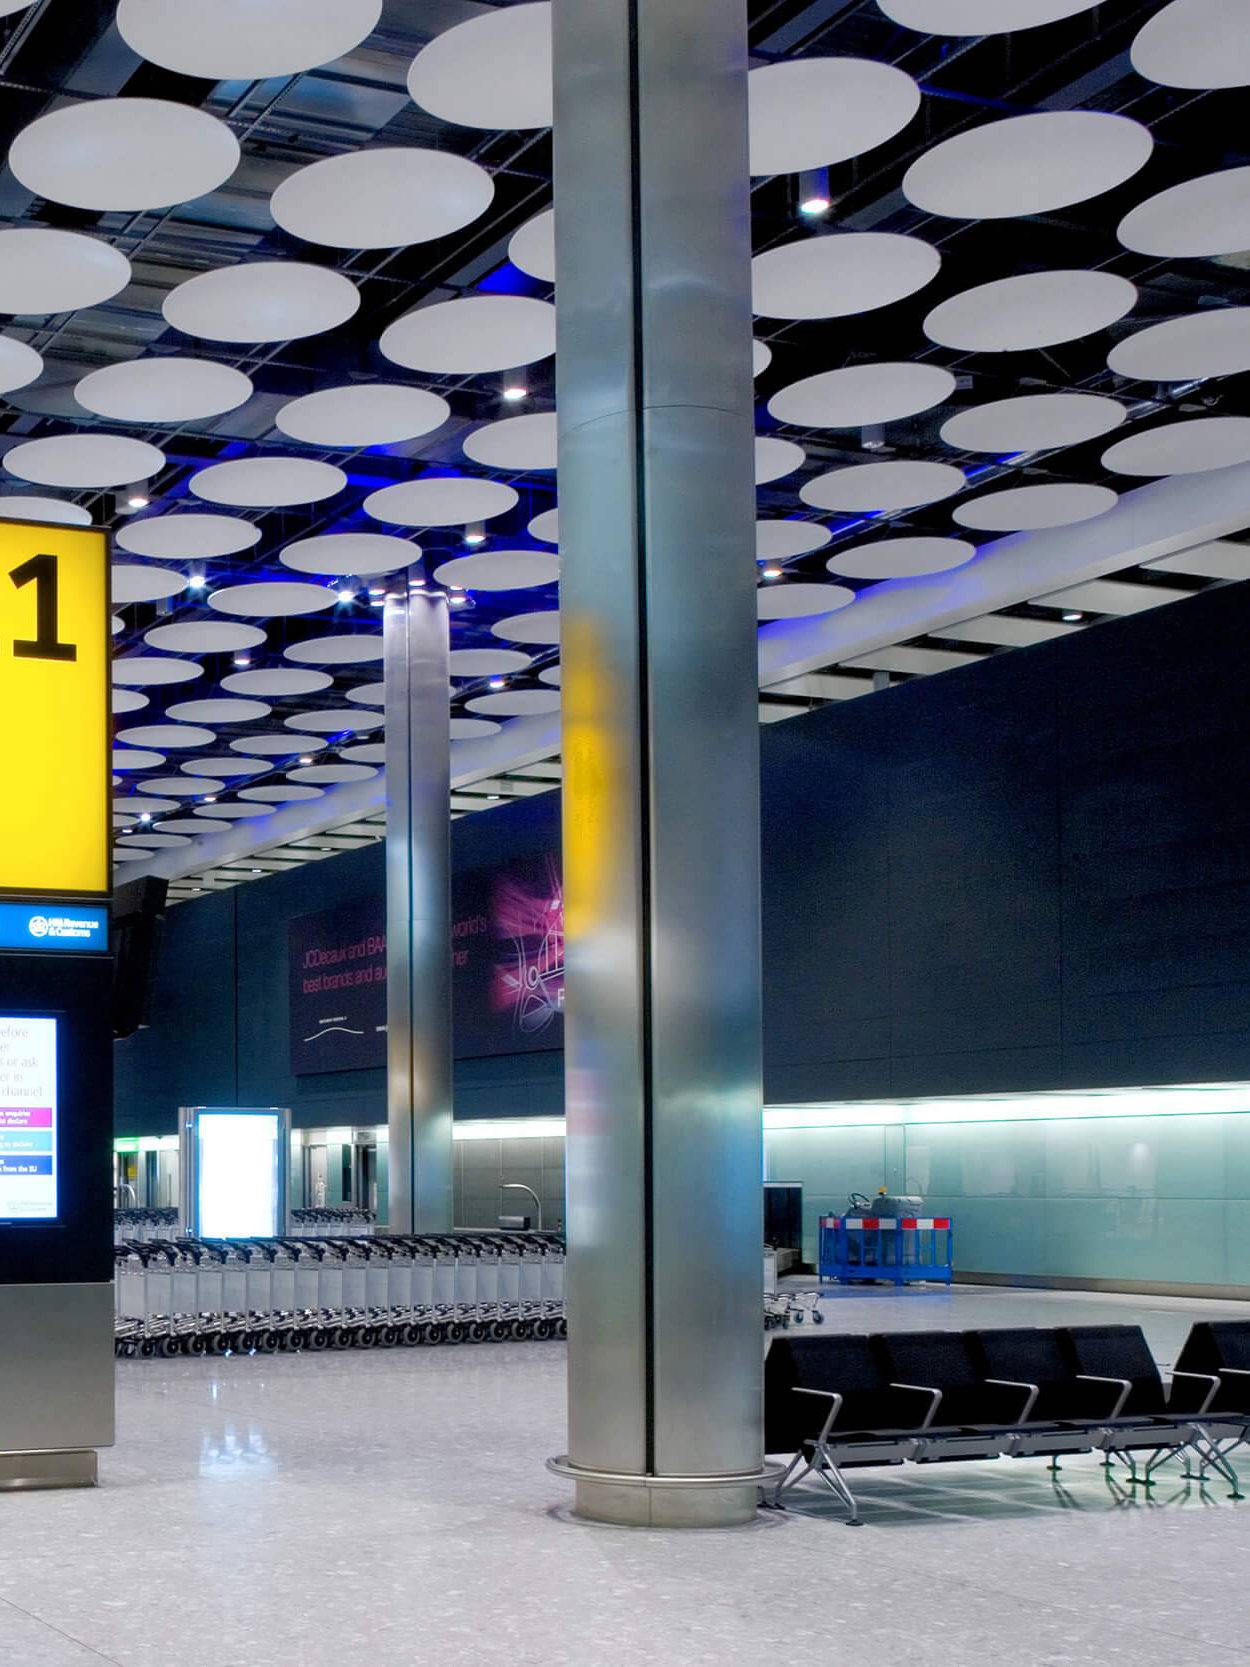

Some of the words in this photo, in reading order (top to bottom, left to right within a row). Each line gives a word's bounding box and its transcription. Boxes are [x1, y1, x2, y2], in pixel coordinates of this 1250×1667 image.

[7, 1059, 17, 1067] or
[21, 1057, 39, 1067] ask
[1, 1085, 42, 1097] channel
